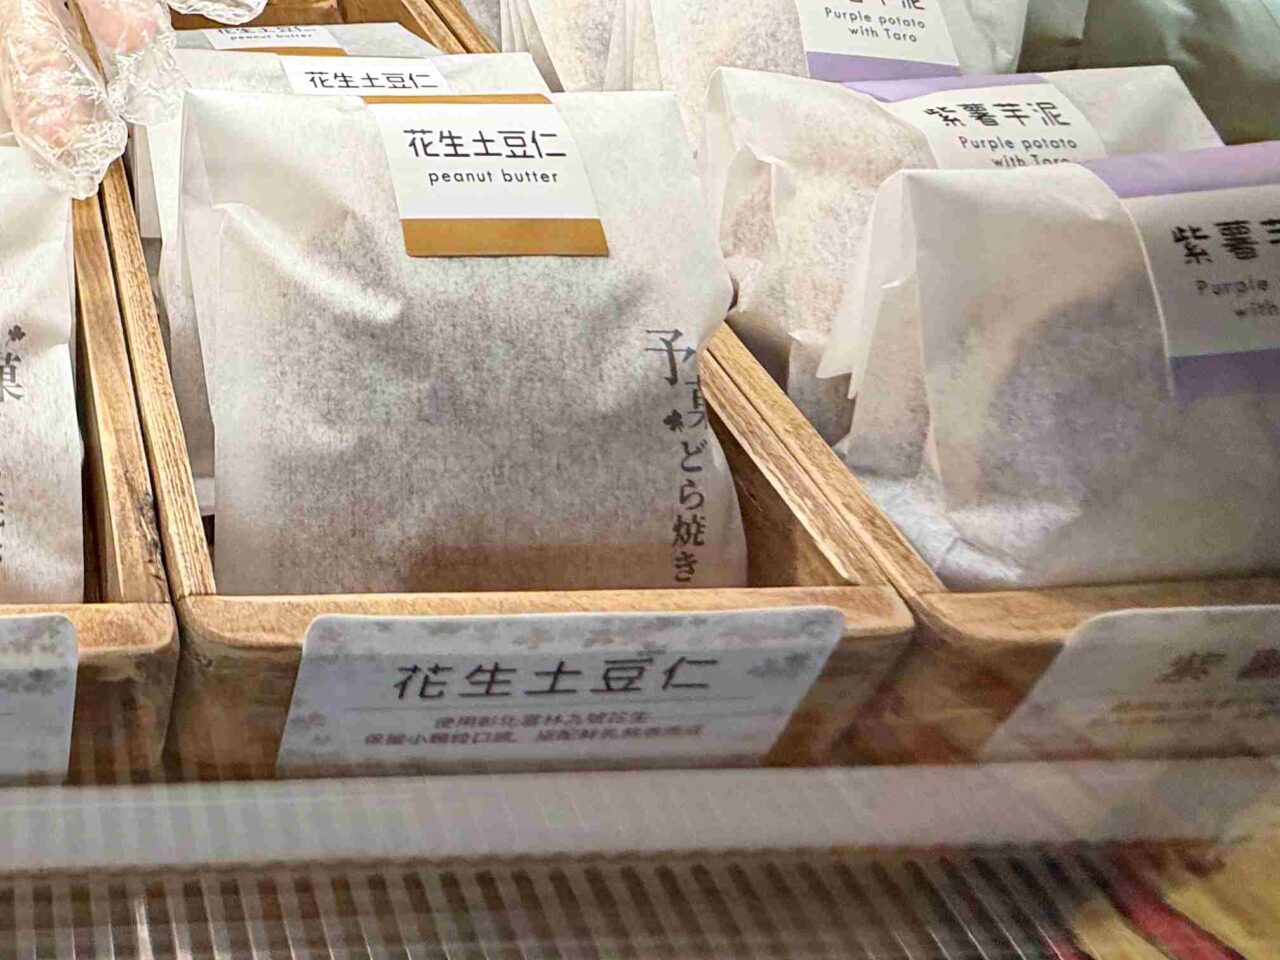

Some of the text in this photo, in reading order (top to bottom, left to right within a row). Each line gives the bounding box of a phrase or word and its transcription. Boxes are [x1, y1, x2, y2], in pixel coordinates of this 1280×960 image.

[824, 6, 926, 29] Purple potato
[848, 26, 918, 42] with Taro
[304, 70, 439, 89] 花生土豆仁
[924, 101, 1071, 127] 紫薯芋泥
[404, 129, 567, 159] 花生土豆仁
[958, 136, 1078, 151] Purple potato
[428, 169, 558, 186] peanut butter
[393, 656, 719, 699] 花生土豆仁
